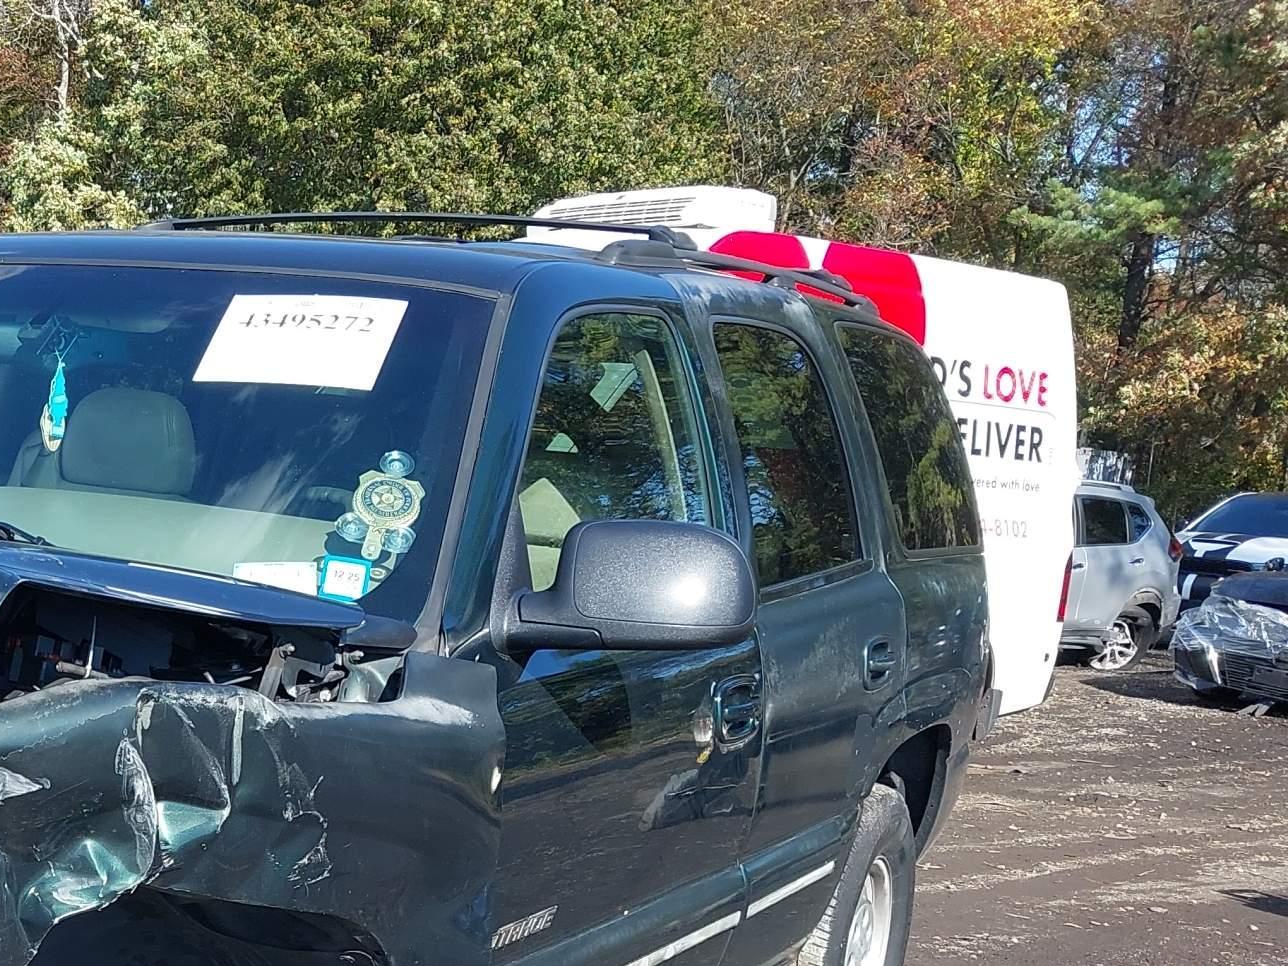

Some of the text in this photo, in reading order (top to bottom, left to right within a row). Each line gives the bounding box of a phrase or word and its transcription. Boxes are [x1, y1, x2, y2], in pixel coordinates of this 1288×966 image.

[238, 313, 375, 332] 43495272
[982, 364, 1049, 407] LOVE
[1000, 479, 1021, 490] with
[1022, 479, 1041, 493] love
